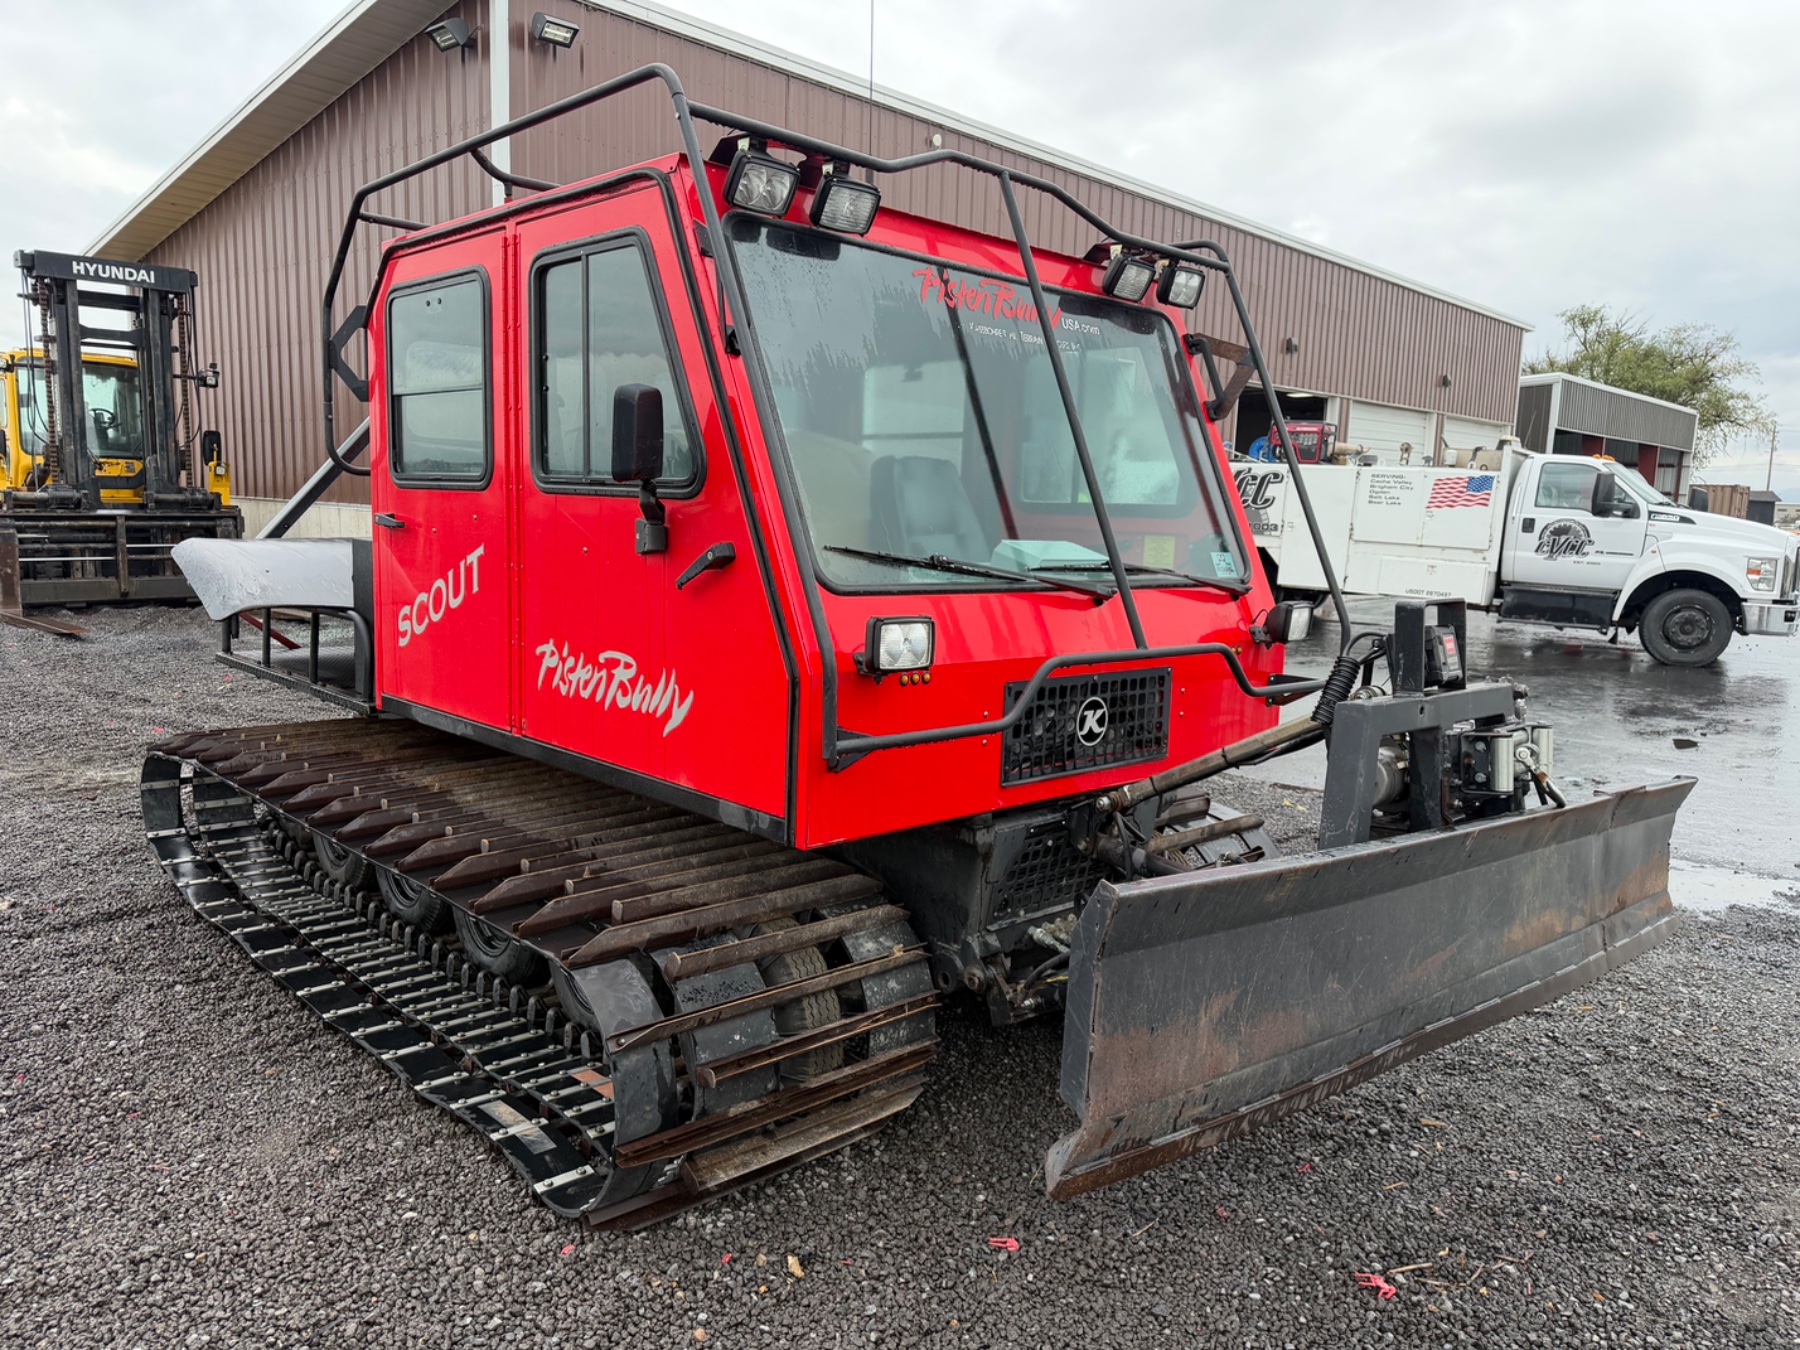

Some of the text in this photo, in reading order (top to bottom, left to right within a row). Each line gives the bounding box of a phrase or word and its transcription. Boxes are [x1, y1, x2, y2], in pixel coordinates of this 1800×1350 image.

[72, 261, 155, 283] HYUNDAI
[913, 265, 1062, 329] PistenBuy
[1249, 522, 1278, 531] 003
[398, 543, 484, 647] SCOUT
[536, 638, 694, 737] PistenBully
